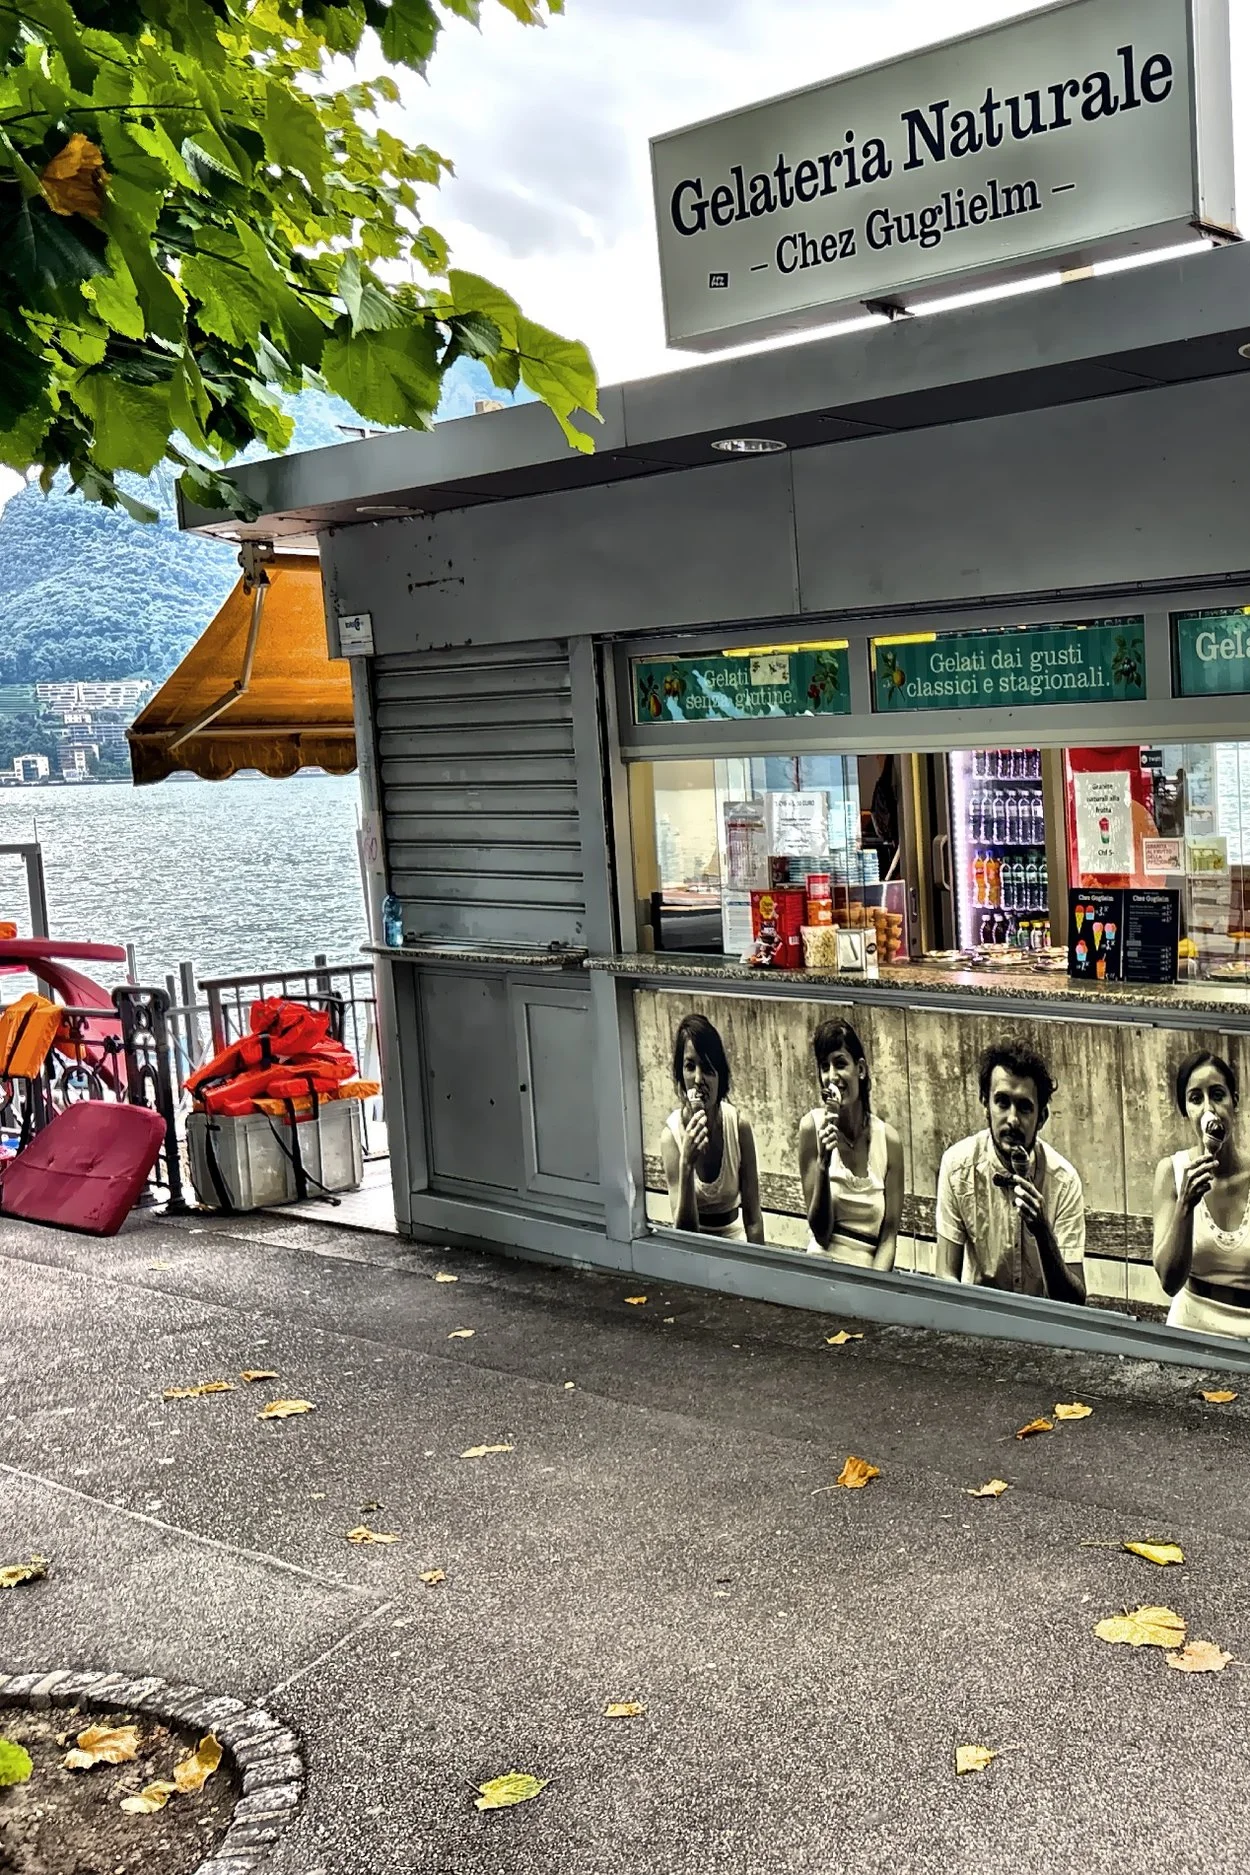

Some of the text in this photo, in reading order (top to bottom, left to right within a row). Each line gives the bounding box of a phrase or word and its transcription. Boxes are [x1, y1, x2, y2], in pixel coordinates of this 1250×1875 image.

[670, 44, 1174, 237] Gelateria Naturale
[775, 178, 1042, 274] Chez Guglielm
[930, 644, 1083, 673] Gelati dai gusti
[704, 669, 749, 688] Gelati
[906, 666, 1110, 697] classici e stagionali.
[735, 688, 797, 710] glutine.
